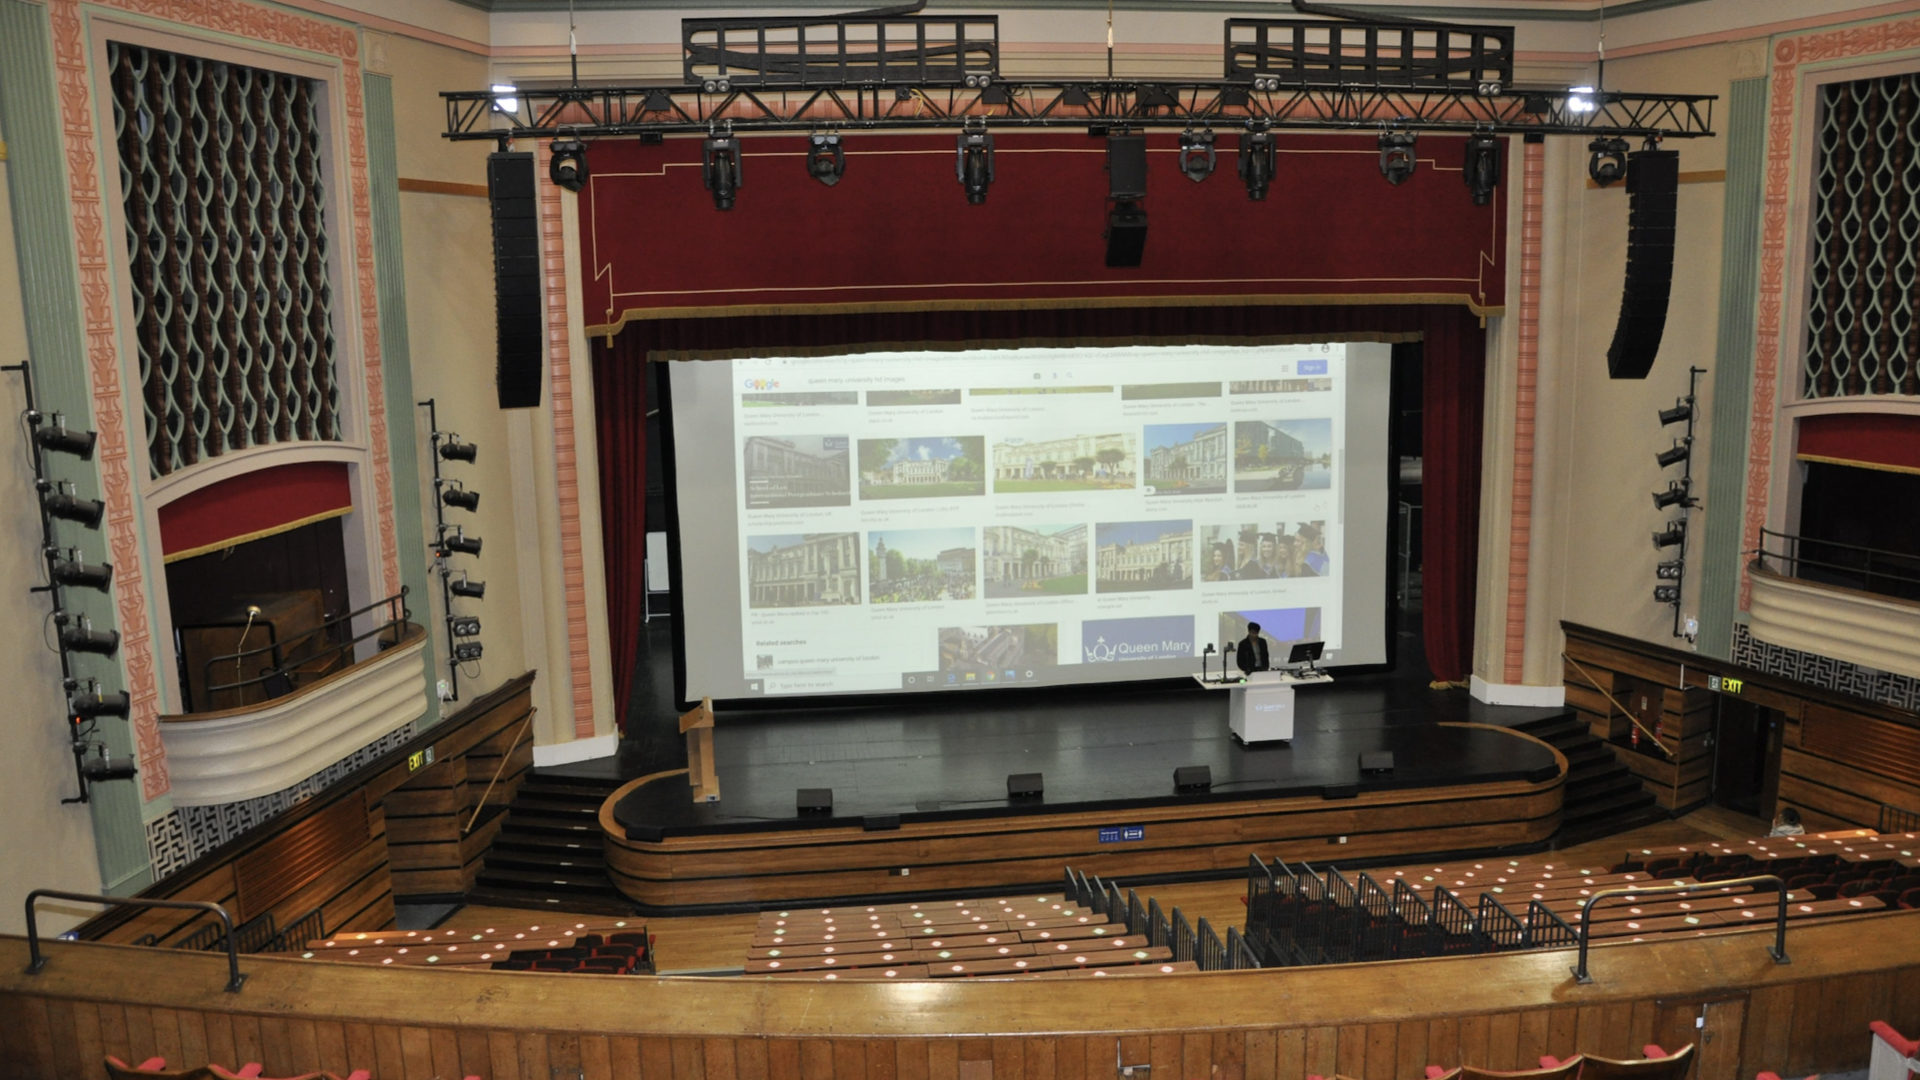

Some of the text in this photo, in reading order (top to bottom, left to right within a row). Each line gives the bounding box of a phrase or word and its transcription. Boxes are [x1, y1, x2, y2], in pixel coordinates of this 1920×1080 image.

[743, 378, 780, 391] Google
[756, 638, 807, 647] Related searches
[1118, 640, 1192, 654] Queen Mary
[1721, 676, 1744, 694] EXIT
[408, 750, 424, 772] EXIT
